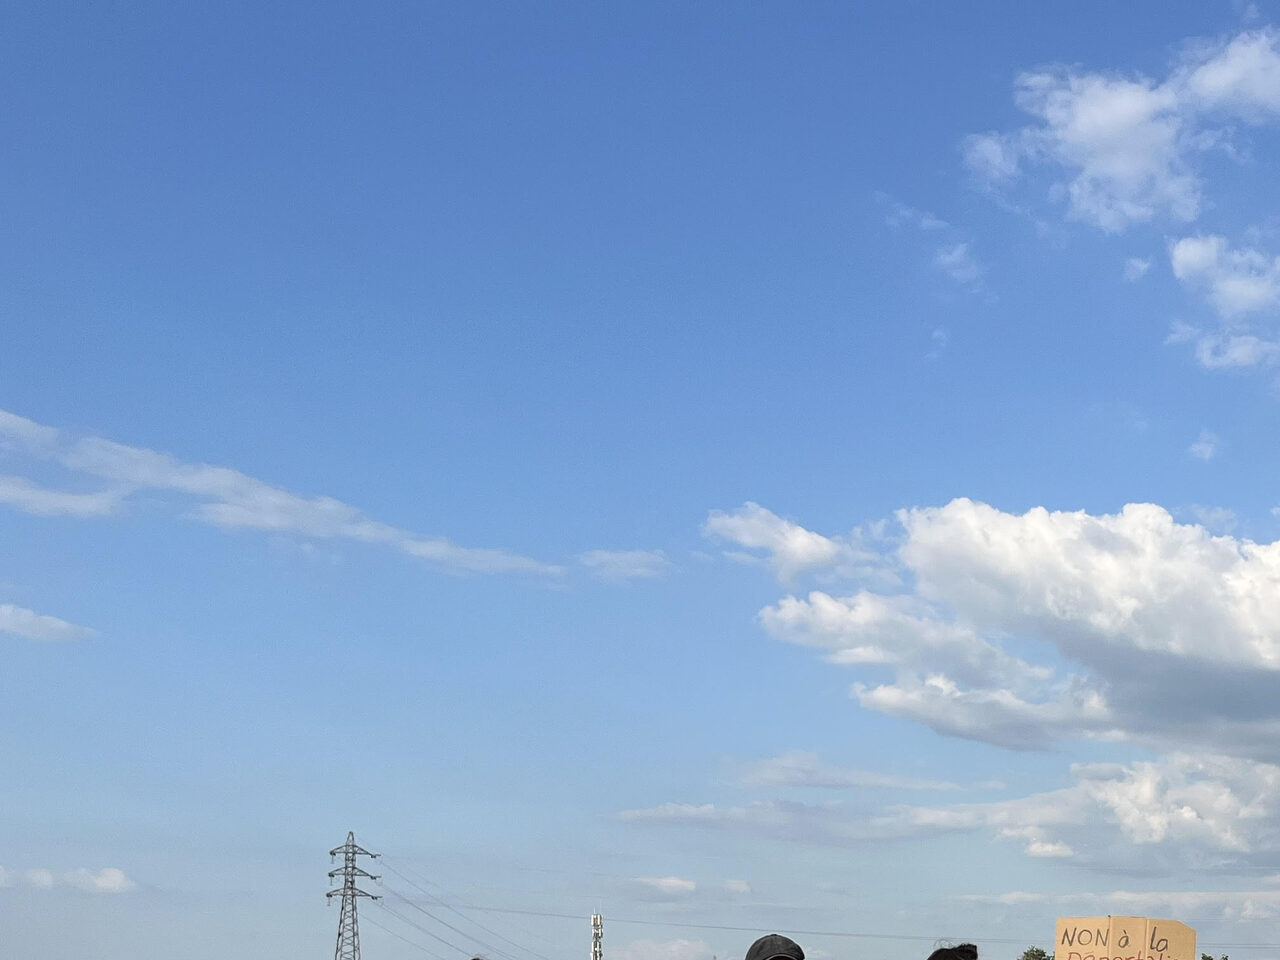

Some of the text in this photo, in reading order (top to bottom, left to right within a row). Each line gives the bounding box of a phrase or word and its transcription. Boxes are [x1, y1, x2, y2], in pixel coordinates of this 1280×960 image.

[1061, 926, 1169, 952] NON à la
